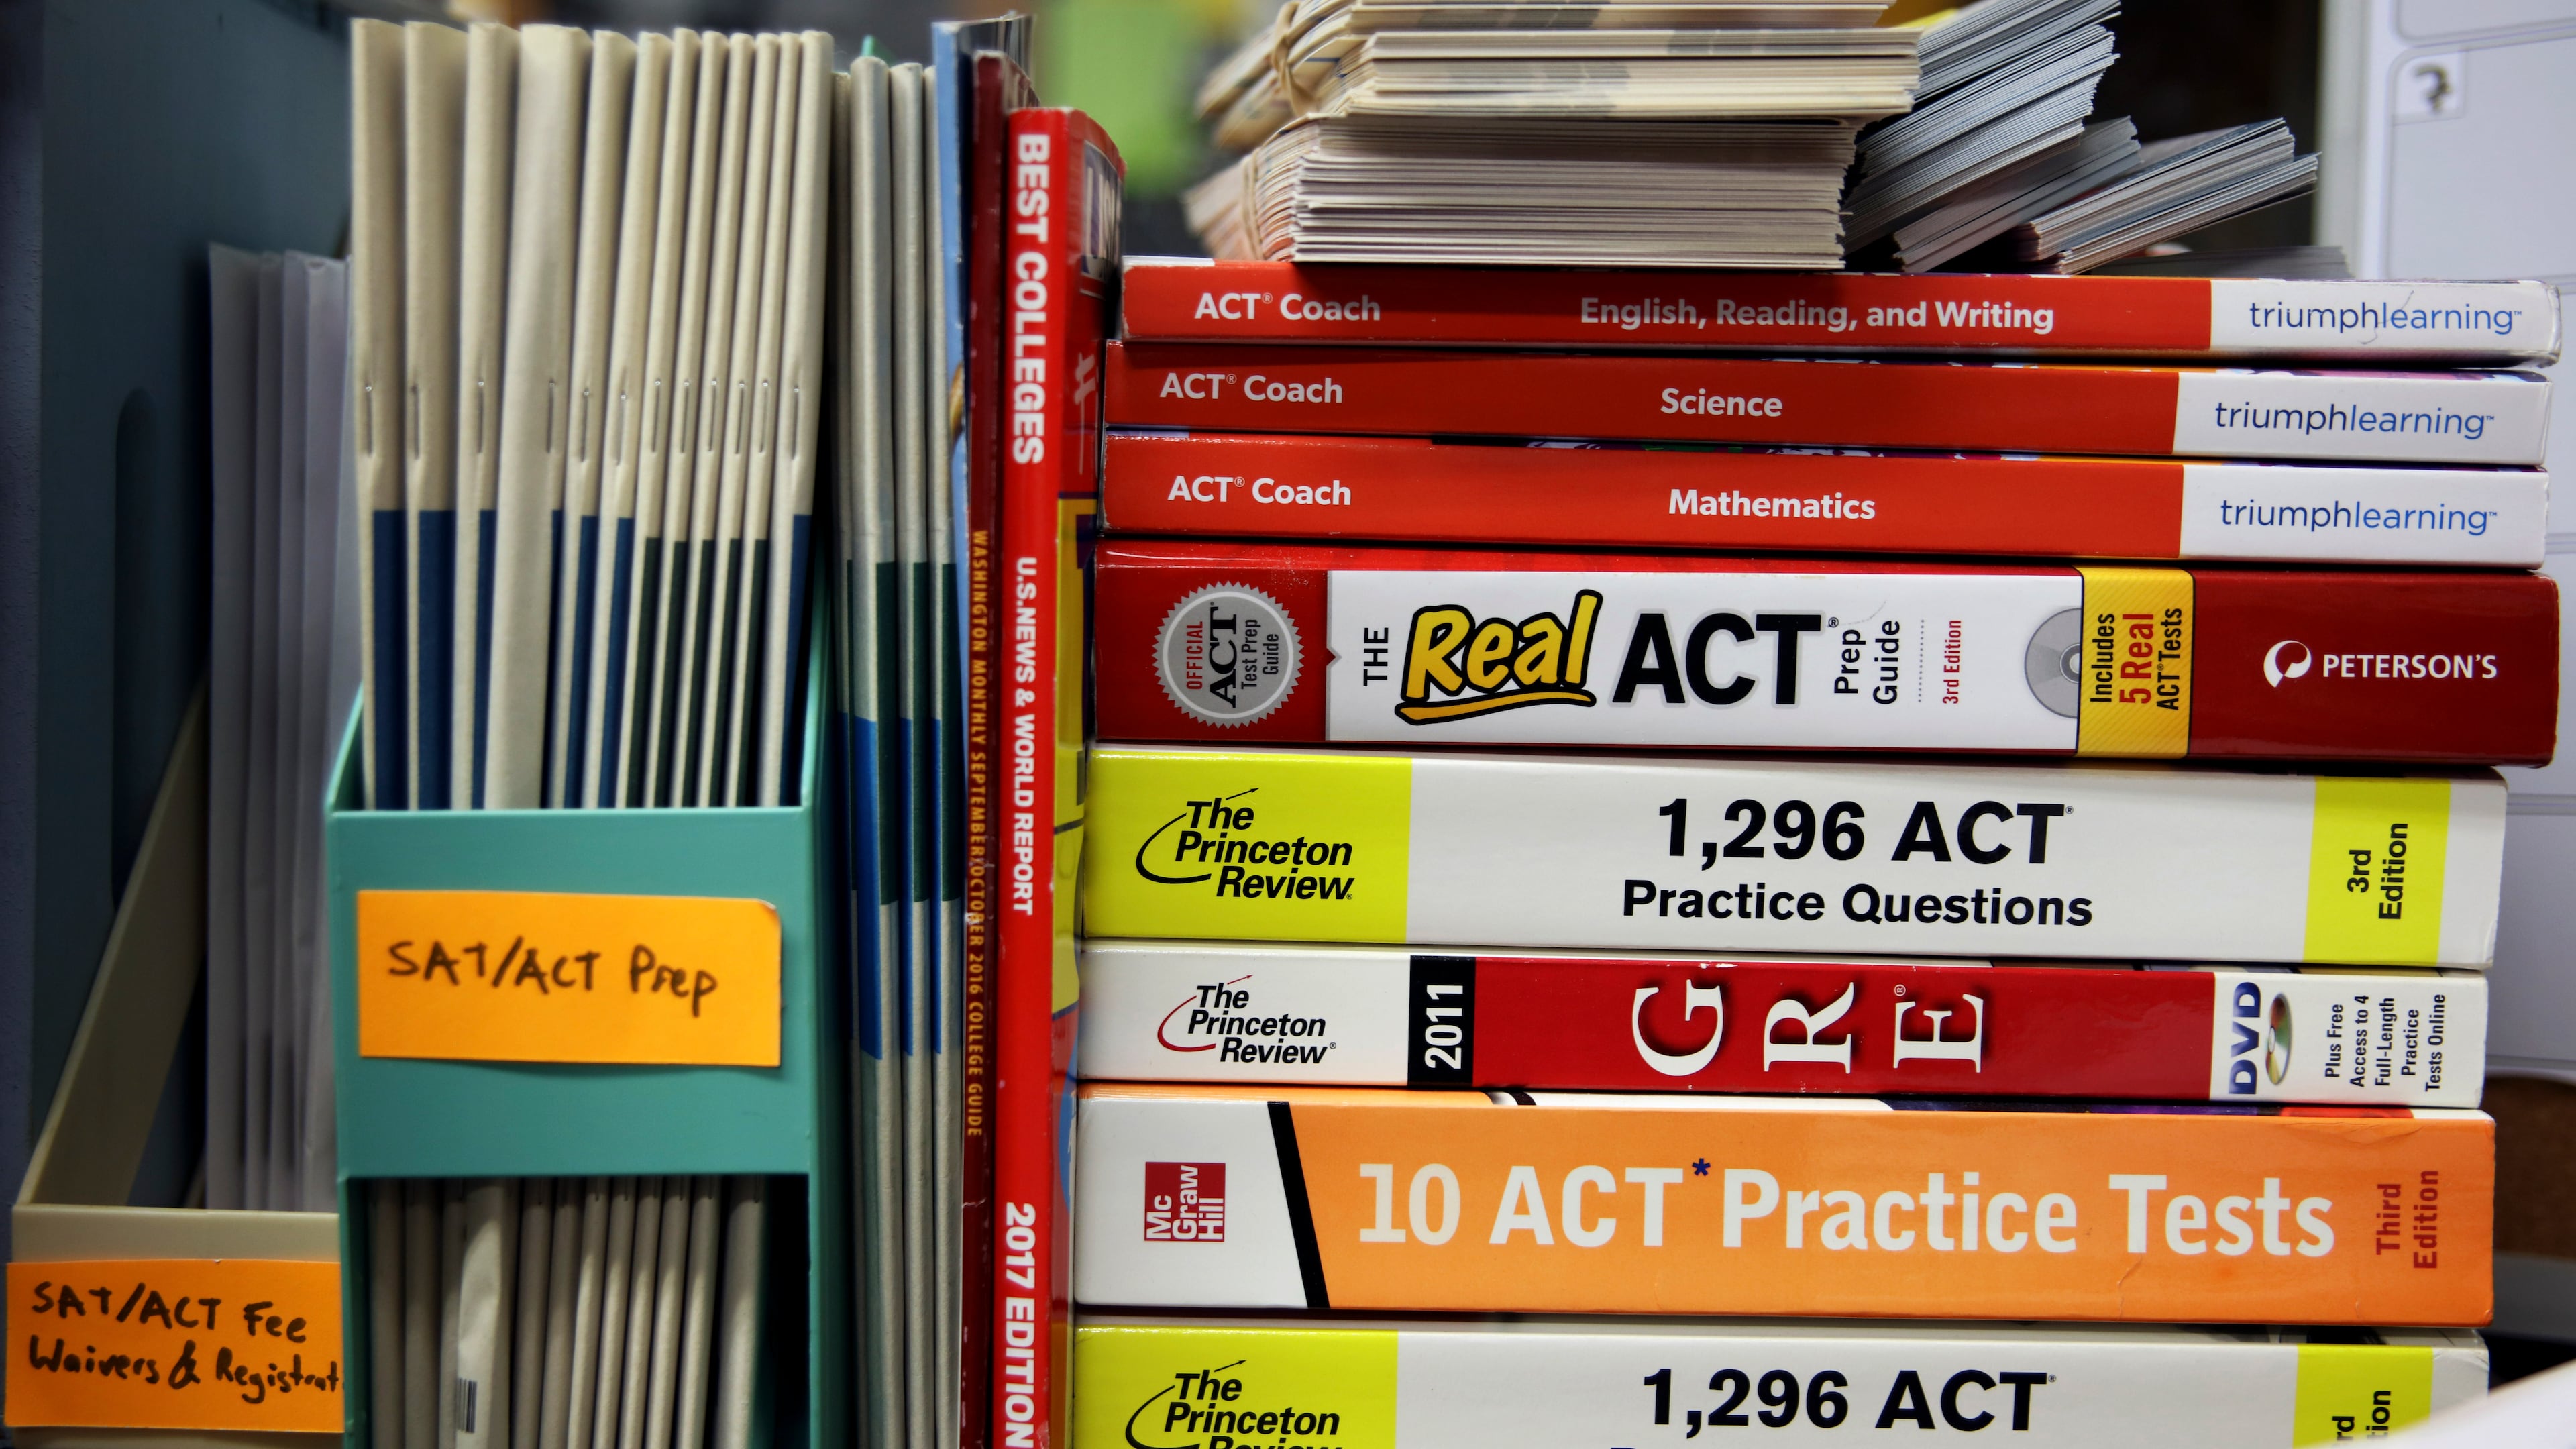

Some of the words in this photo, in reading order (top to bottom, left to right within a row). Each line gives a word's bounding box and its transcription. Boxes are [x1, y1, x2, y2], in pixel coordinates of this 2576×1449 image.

[1016, 133, 1051, 243] BEST
[1280, 294, 1381, 321] Coach
[1580, 297, 1706, 331] English,
[1717, 299, 1857, 333] Reading,
[1866, 301, 1927, 327] and
[1934, 301, 2054, 335] Writing
[1012, 252, 1048, 464] COLLEGES
[1244, 375, 1342, 403] Coach
[1660, 388, 1783, 417] Science
[1252, 478, 1351, 506] Coach
[1668, 489, 1876, 519] Mathematics
[971, 530, 989, 655] WASHINGTON
[1014, 557, 1037, 683] U.S.NEWS
[1242, 619, 1260, 655] Prep
[1364, 627, 1389, 686] THE
[1401, 589, 1603, 702] Real
[1944, 619, 1962, 672] Edition
[2121, 614, 2154, 679] Real
[1187, 621, 1203, 690] OFFICIAL
[1242, 658, 1257, 689] Test
[1263, 633, 1279, 675] Guide
[1834, 629, 1866, 694] Prep
[1872, 619, 1900, 704] Guide
[2090, 613, 2115, 702] Includes
[2323, 654, 2498, 679] PETERSON'S
[970, 660, 988, 745] MONTHLY
[1014, 689, 1036, 707] &
[1943, 679, 1960, 704] 3rd
[2119, 688, 2151, 704] 5
[1014, 713, 1035, 807] WORLD
[1187, 797, 1254, 830] The
[1658, 798, 1865, 871] 1,296
[1013, 812, 1034, 916] REPORT
[1175, 830, 1353, 866] Princeton
[2347, 849, 2371, 893] 3rd
[2379, 823, 2408, 920] Edition
[1623, 879, 1825, 921] Practice
[1842, 883, 2094, 927] Questions
[387, 936, 602, 995] SAT/ACT
[629, 944, 718, 1018] Prep
[969, 953, 984, 994] 2016
[1196, 983, 1250, 1009] The
[2354, 994, 2369, 1004] 4
[968, 1003, 984, 1075] COLLEGE
[1188, 1010, 1326, 1037] Princeton
[1424, 985, 1464, 1070] 2011
[2229, 981, 2261, 1095] DVD
[2327, 1004, 2343, 1038] Free
[2355, 1009, 2369, 1023] to
[2375, 997, 2398, 1086] Full-Length
[2401, 1008, 2419, 1076] Practice
[2428, 994, 2446, 1046] Online
[2324, 1043, 2341, 1077] Plus
[2350, 1029, 2367, 1087] Access
[2425, 1051, 2443, 1092] Tests
[968, 1083, 983, 1136] GUIDE
[1146, 1195, 1172, 1240] Mc
[1172, 1165, 1199, 1240] Graw
[1198, 1197, 1224, 1240] Hill
[1359, 1163, 1460, 1246] 10
[1723, 1169, 2077, 1253] Practice
[2109, 1174, 2334, 1257] Tests
[2376, 1183, 2401, 1255] Third
[2413, 1171, 2439, 1269] Edition
[1006, 1201, 1036, 1289] 2017
[32, 1282, 221, 1330] SAT/ACT
[244, 1301, 307, 1343] Fee
[29, 1334, 160, 1385] Waivers
[168, 1340, 201, 1390] &
[215, 1346, 344, 1404] Registrat
[1005, 1297, 1036, 1449] EDITION
[1175, 1369, 1242, 1401] The
[1164, 1402, 1340, 1436] Princeton
[1644, 1368, 1849, 1439] 1,296
[2332, 1415, 2355, 1444] rd
